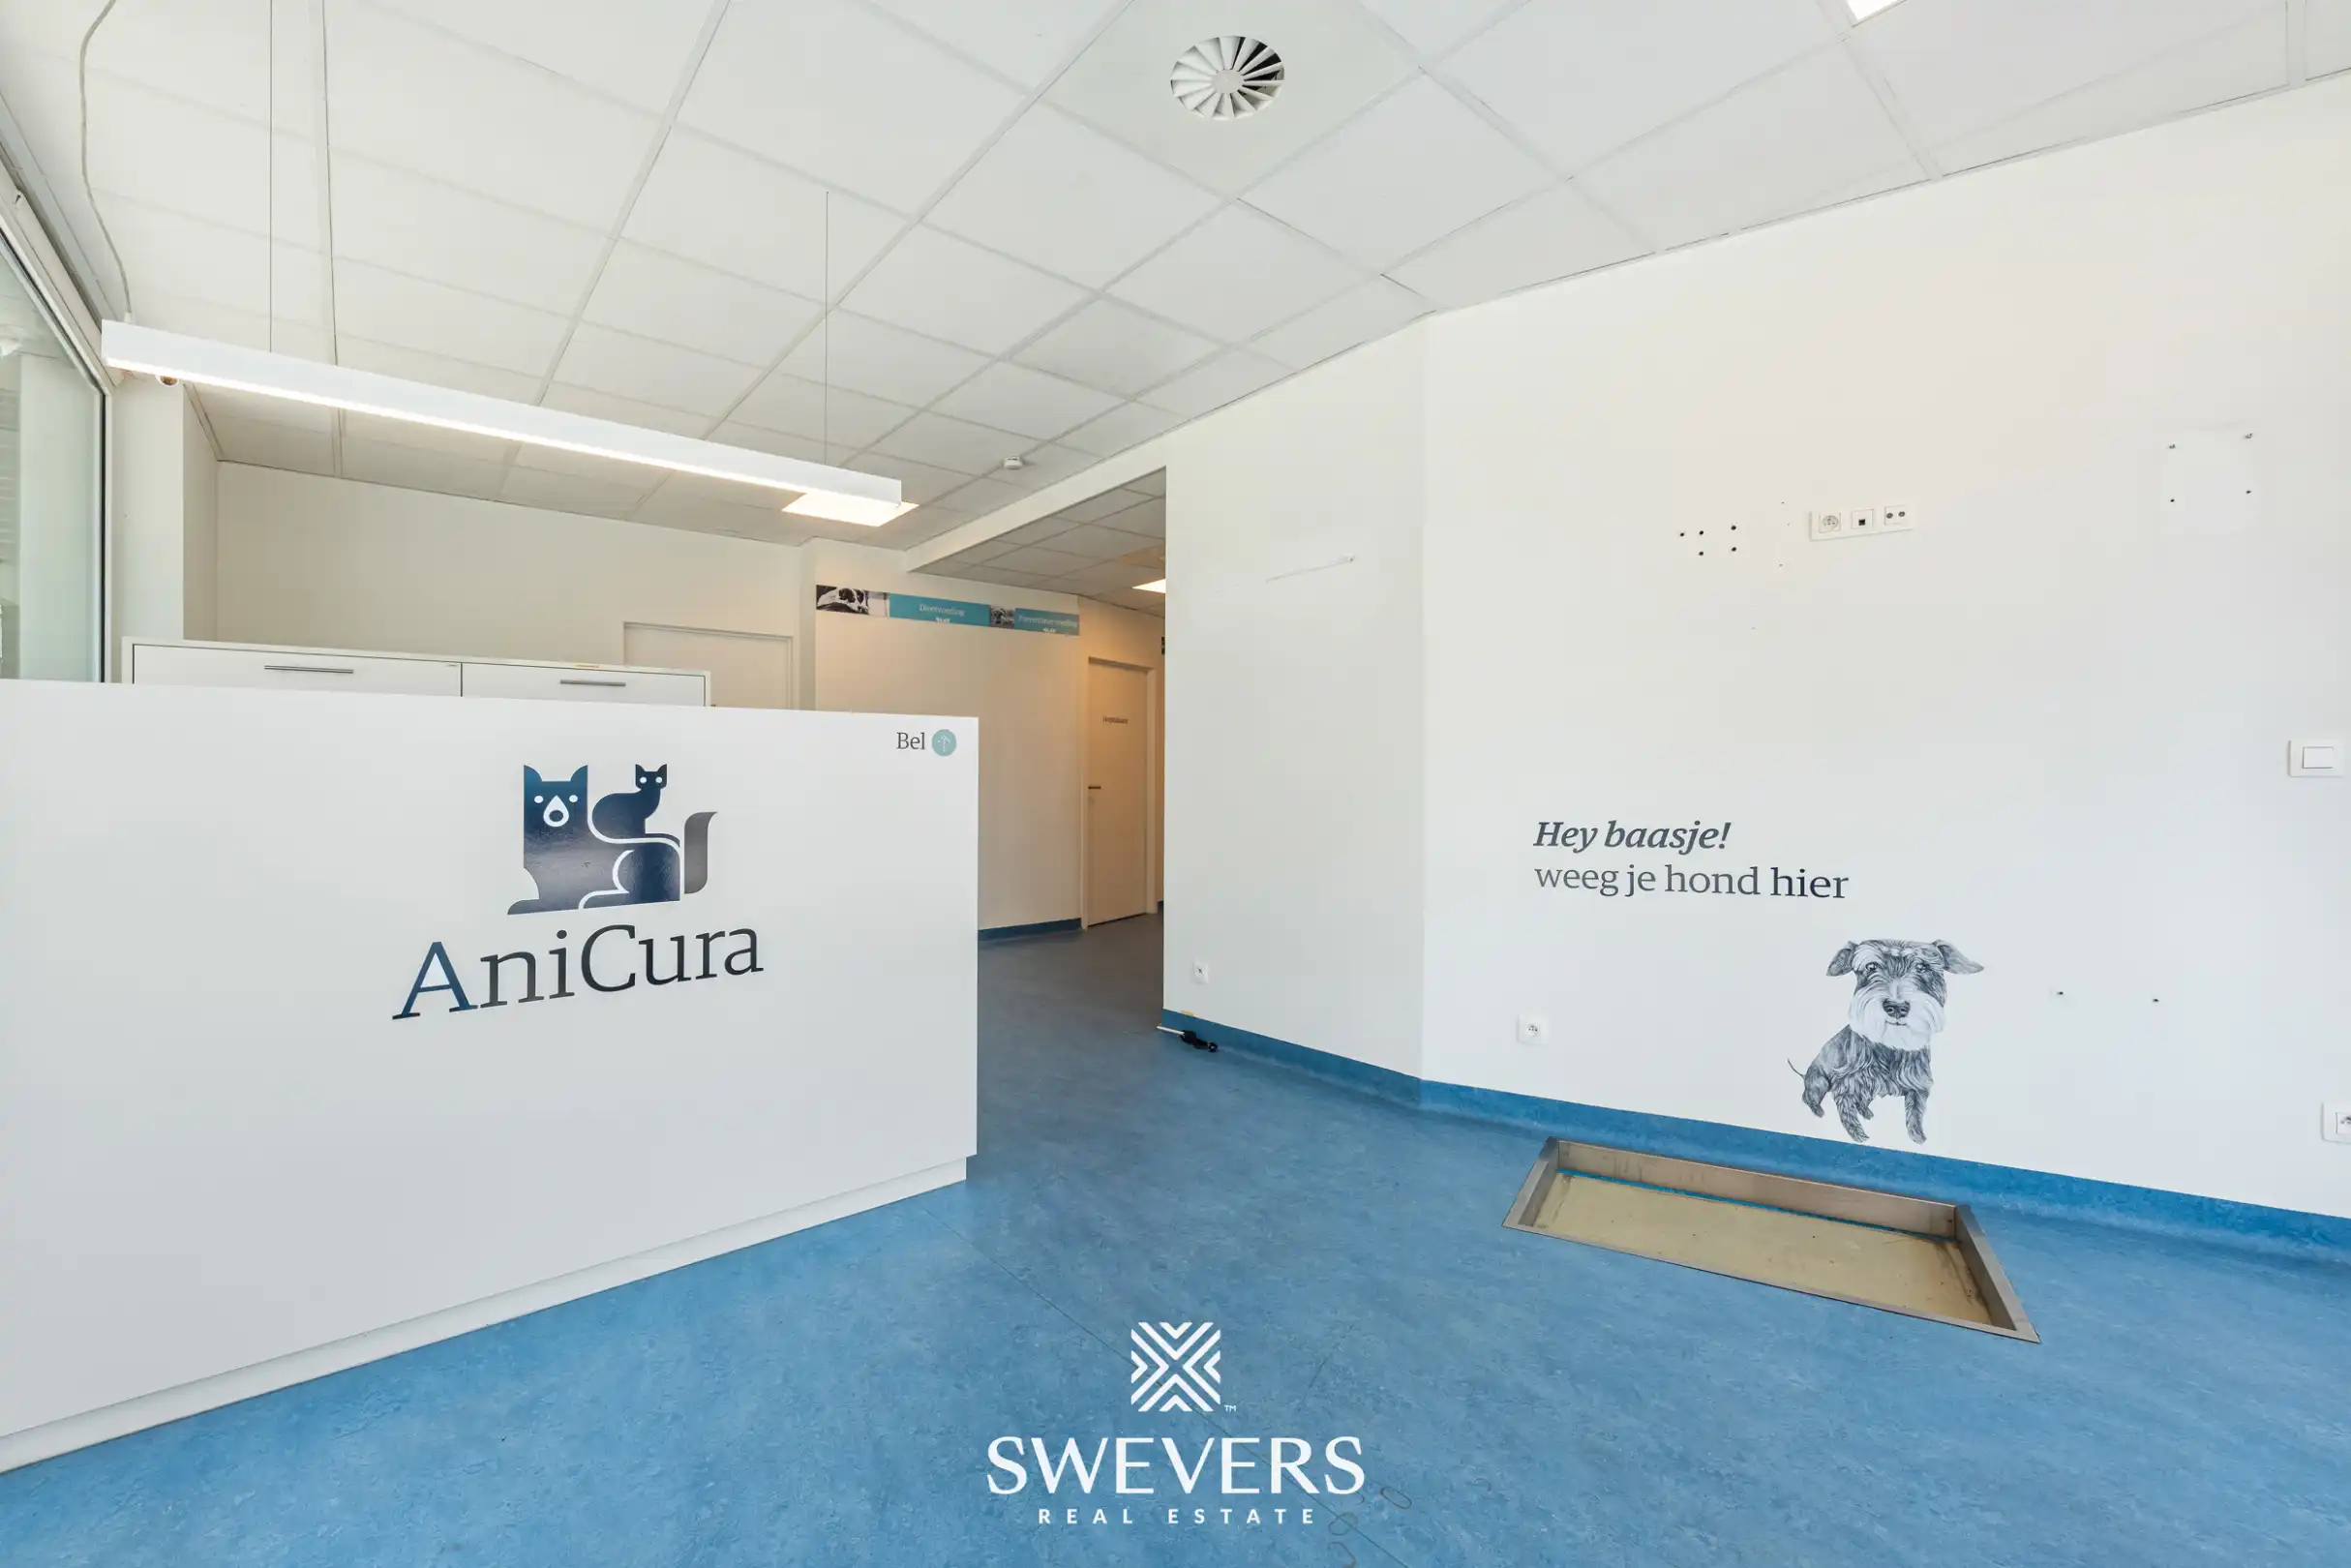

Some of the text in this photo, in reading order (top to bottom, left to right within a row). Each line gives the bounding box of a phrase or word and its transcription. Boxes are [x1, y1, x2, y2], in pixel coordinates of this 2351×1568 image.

[896, 732, 925, 750] Bel
[1532, 820, 1733, 856] Hey baasje!
[1533, 863, 1850, 899] weeg je hond hier
[391, 923, 765, 1021] AniCura
